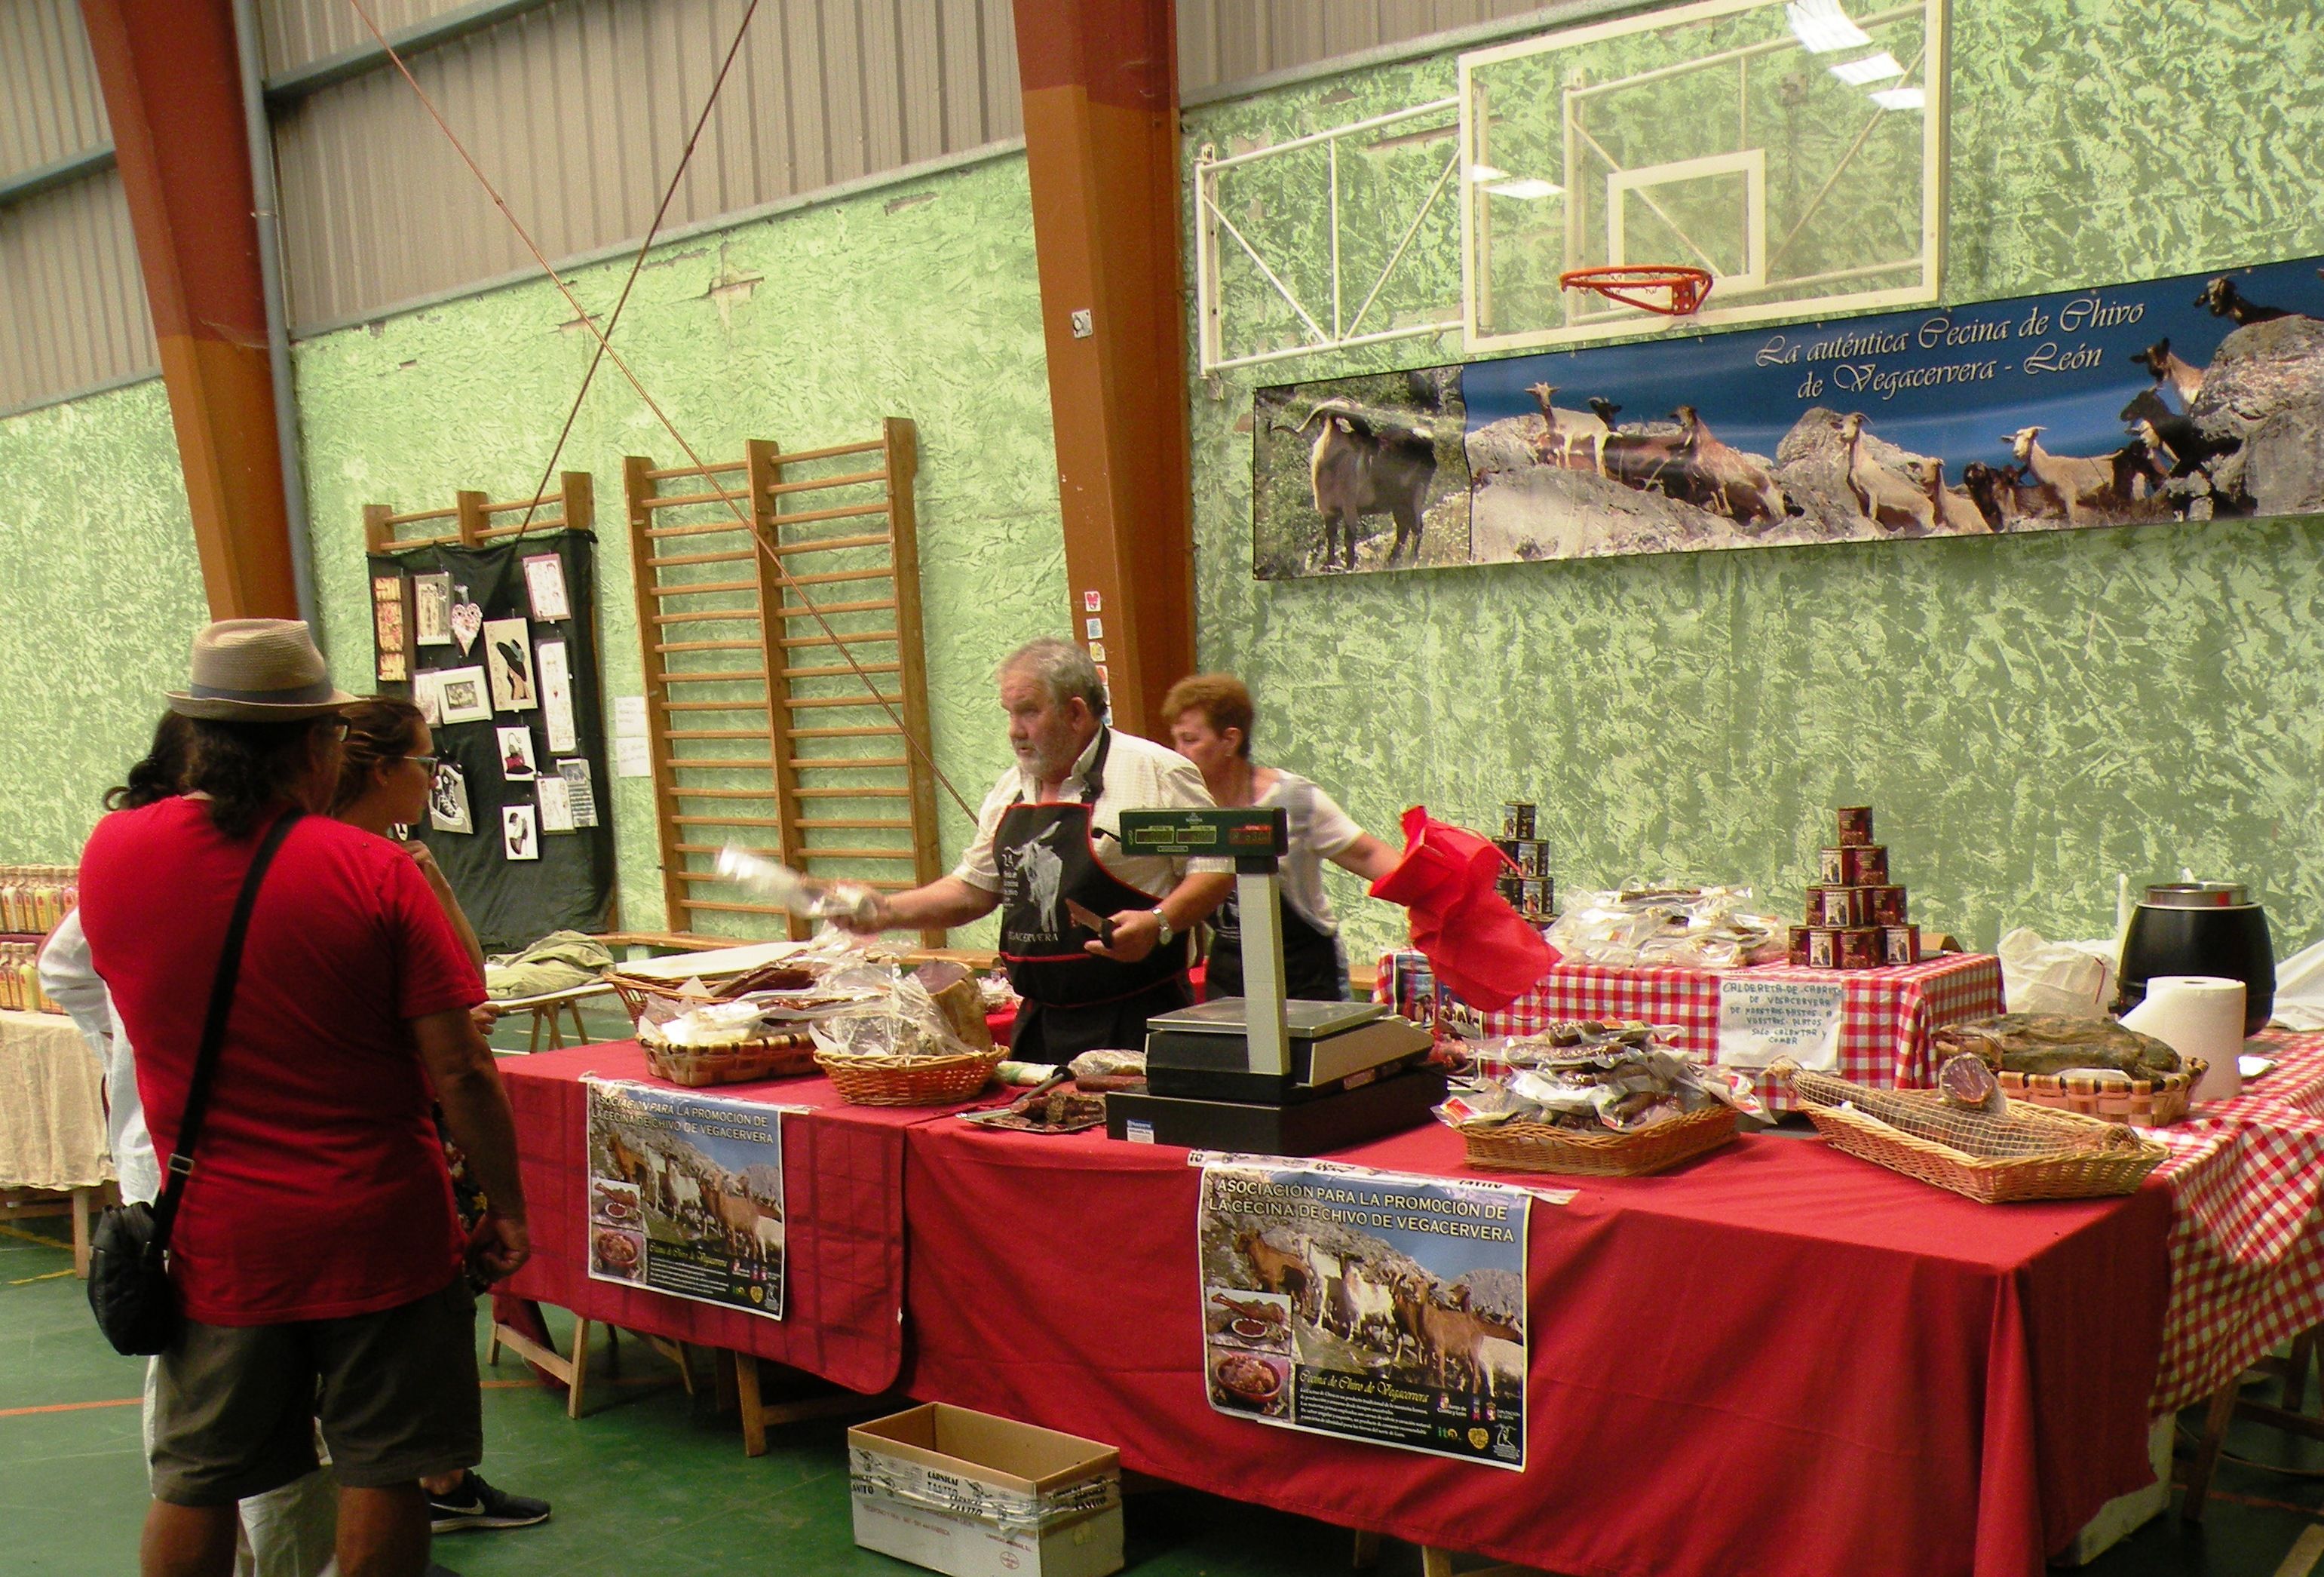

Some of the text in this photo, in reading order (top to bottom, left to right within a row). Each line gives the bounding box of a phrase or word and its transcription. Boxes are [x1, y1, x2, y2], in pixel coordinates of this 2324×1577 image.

[1755, 299, 2145, 367] La auténtica Cecina de Chivo
[1797, 371, 1823, 399] de
[1833, 363, 1995, 400] Vegacervera
[2023, 341, 2103, 375] León
[1722, 982, 1783, 993] CALDERETA
[1730, 1006, 1741, 1014] DE
[1749, 996, 1760, 1004] DE
[754, 1115, 768, 1128] DE
[700, 1124, 774, 1144] VEGACERVERA
[1217, 1180, 1507, 1220] ASOCIACIÓN PARA LA PROMOCIÓN DE
[1209, 1198, 1515, 1243] LA CECINA DE CHIVO DE VEGACERVERA
